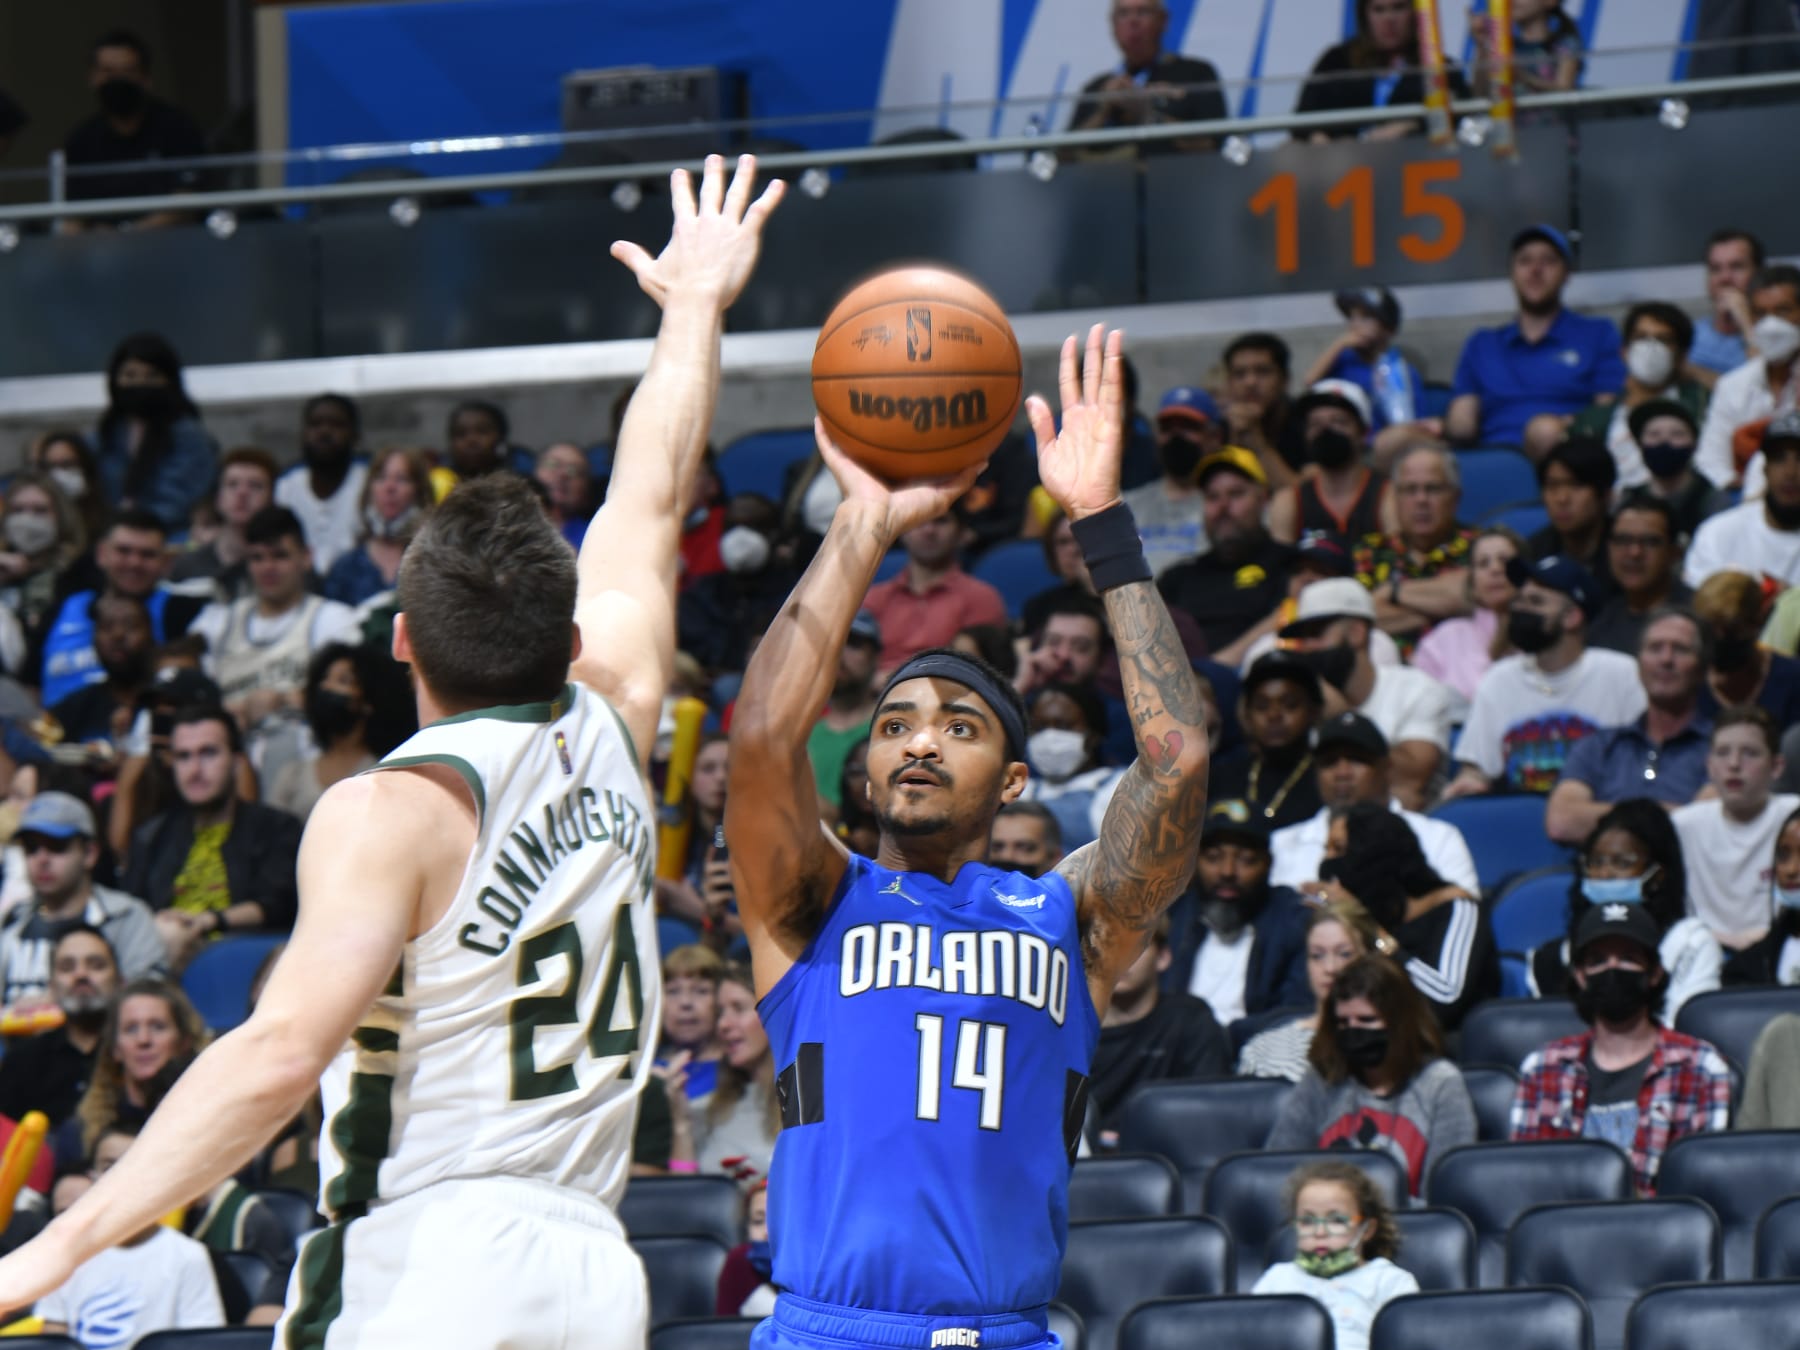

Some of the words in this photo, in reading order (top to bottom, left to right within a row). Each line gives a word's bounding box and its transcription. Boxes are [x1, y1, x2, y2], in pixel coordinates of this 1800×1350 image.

[1249, 159, 1465, 273] 115
[848, 386, 987, 433] Wilson
[509, 898, 645, 1103] 24
[839, 920, 1069, 1028] ORLANDO
[915, 1012, 1008, 1132] 14
[930, 1327, 981, 1349] MAGIC
